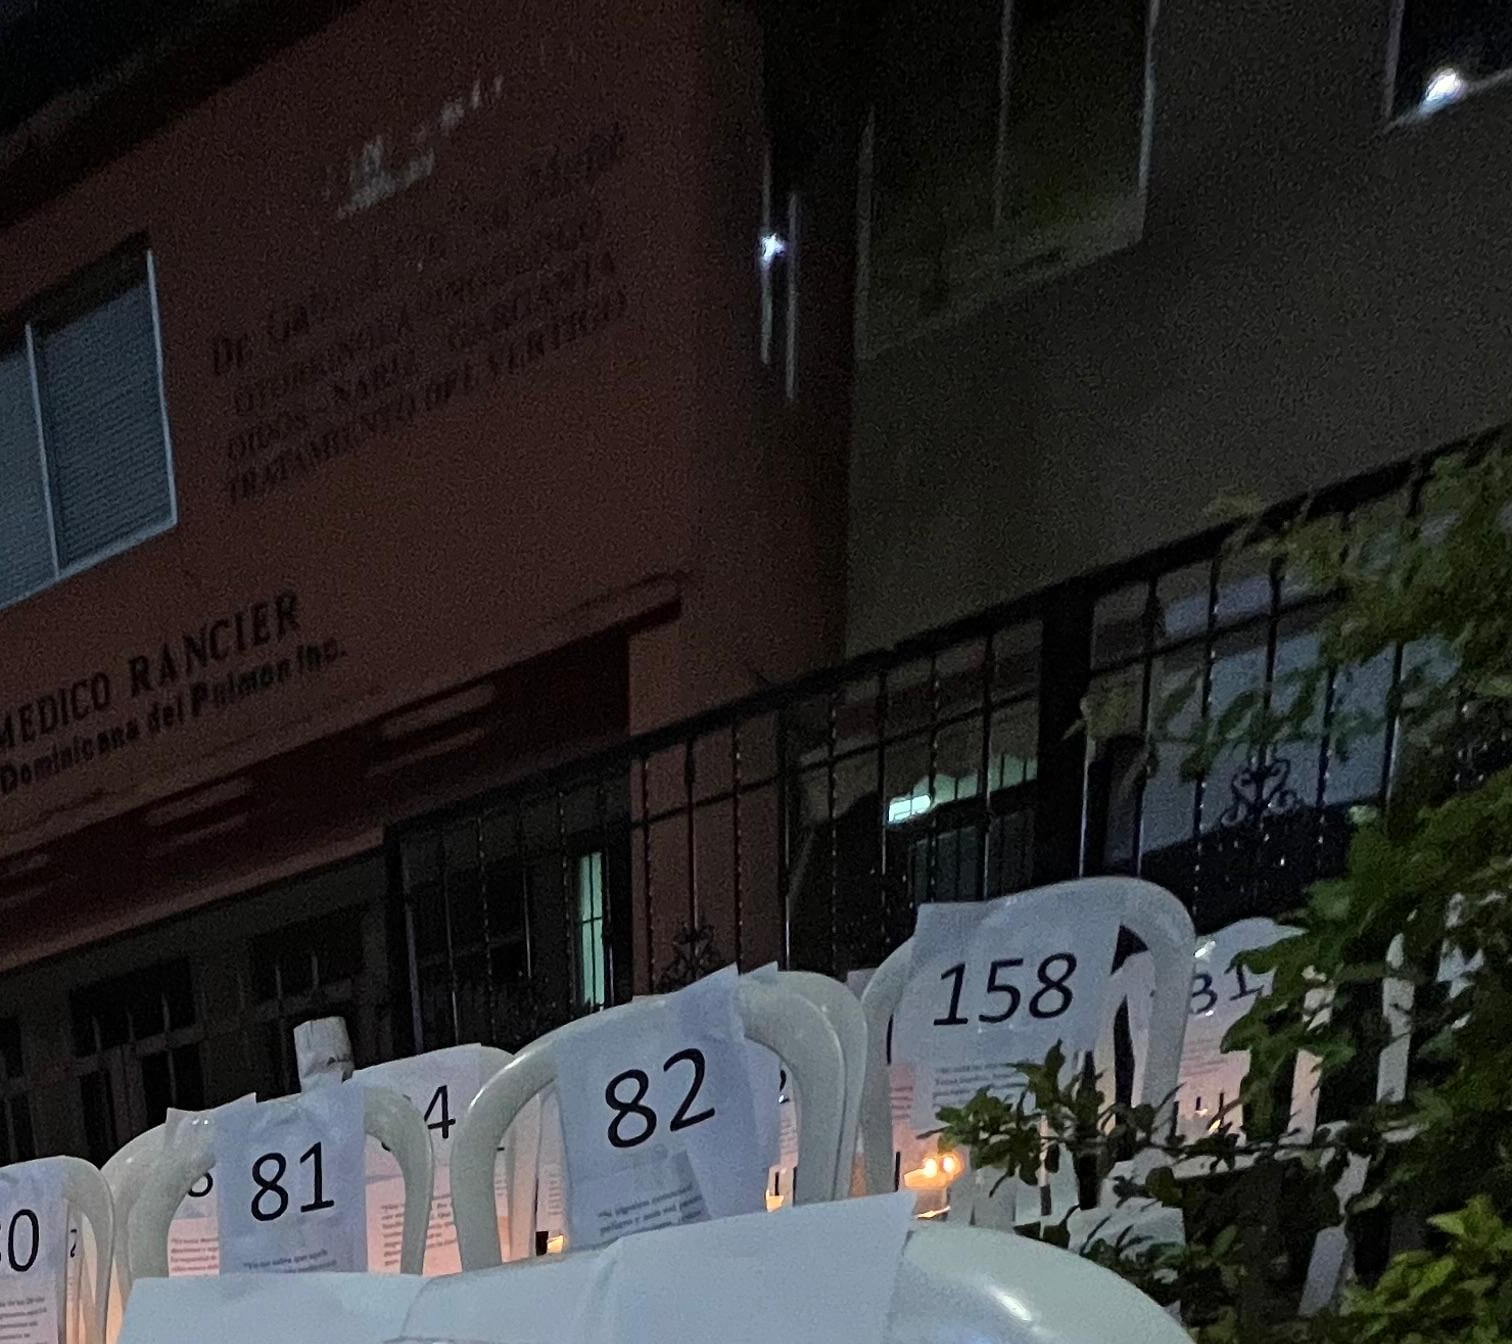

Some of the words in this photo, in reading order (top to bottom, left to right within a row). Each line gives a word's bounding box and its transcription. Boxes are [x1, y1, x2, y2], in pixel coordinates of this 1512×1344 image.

[127, 589, 299, 698] RANCIER
[147, 694, 185, 736] del
[931, 951, 1079, 1030] 158
[422, 1084, 457, 1140] 4
[603, 1047, 717, 1149] 82
[249, 1140, 336, 1222] 81
